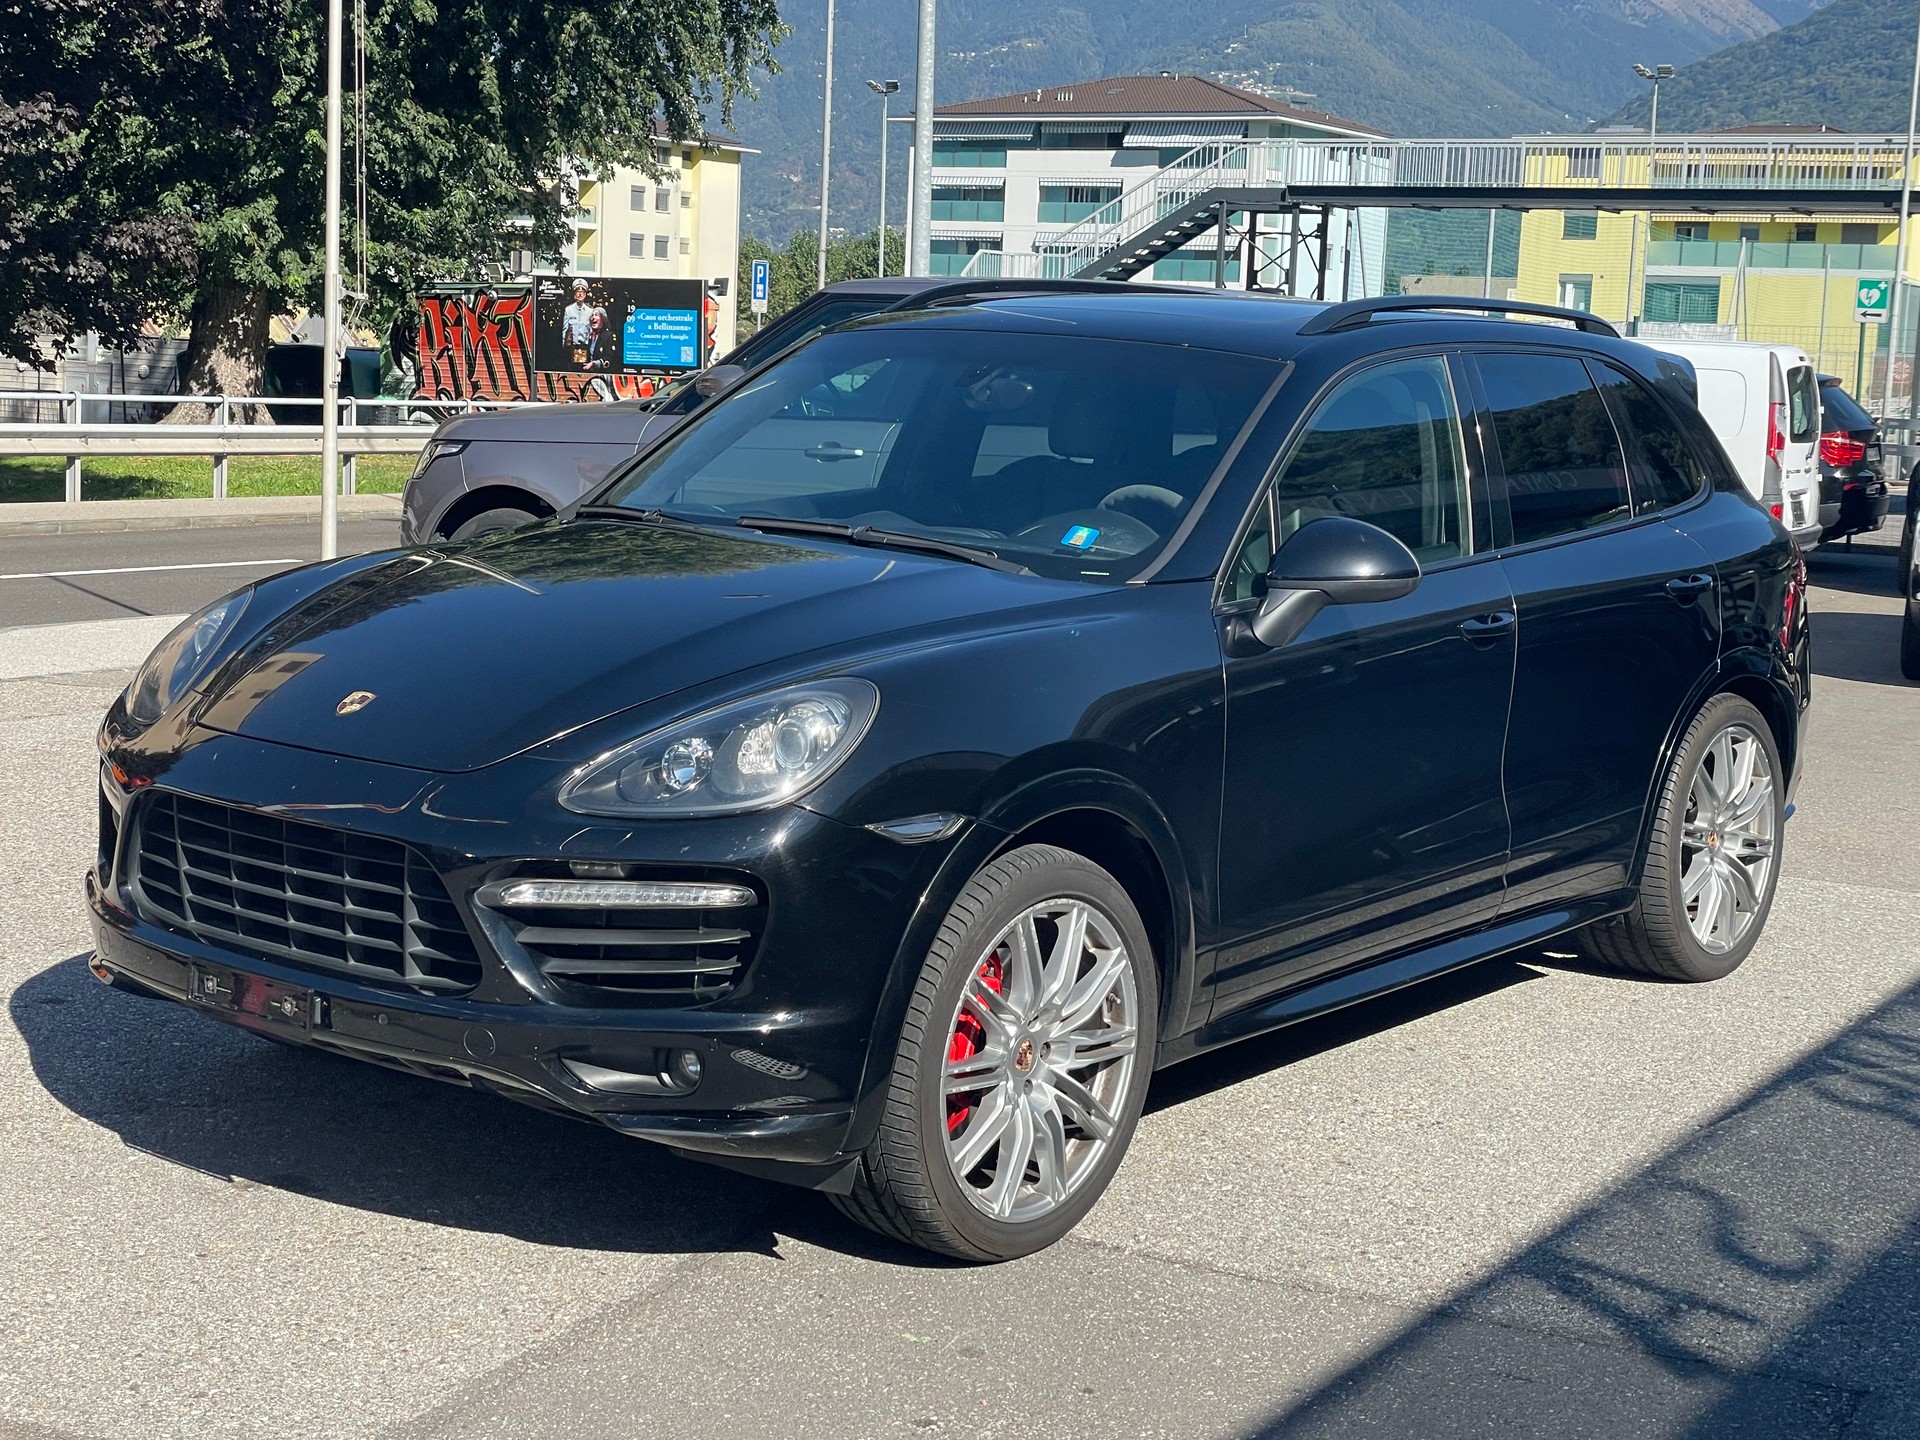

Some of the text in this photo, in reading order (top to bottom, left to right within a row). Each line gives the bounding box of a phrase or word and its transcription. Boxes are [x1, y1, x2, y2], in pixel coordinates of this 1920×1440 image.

[756, 265, 764, 284] P
[627, 305, 636, 313] 19
[626, 315, 636, 323] 09
[657, 313, 694, 322] orchestrale
[626, 325, 636, 334] 26
[653, 322, 692, 331] Bellinzona»
